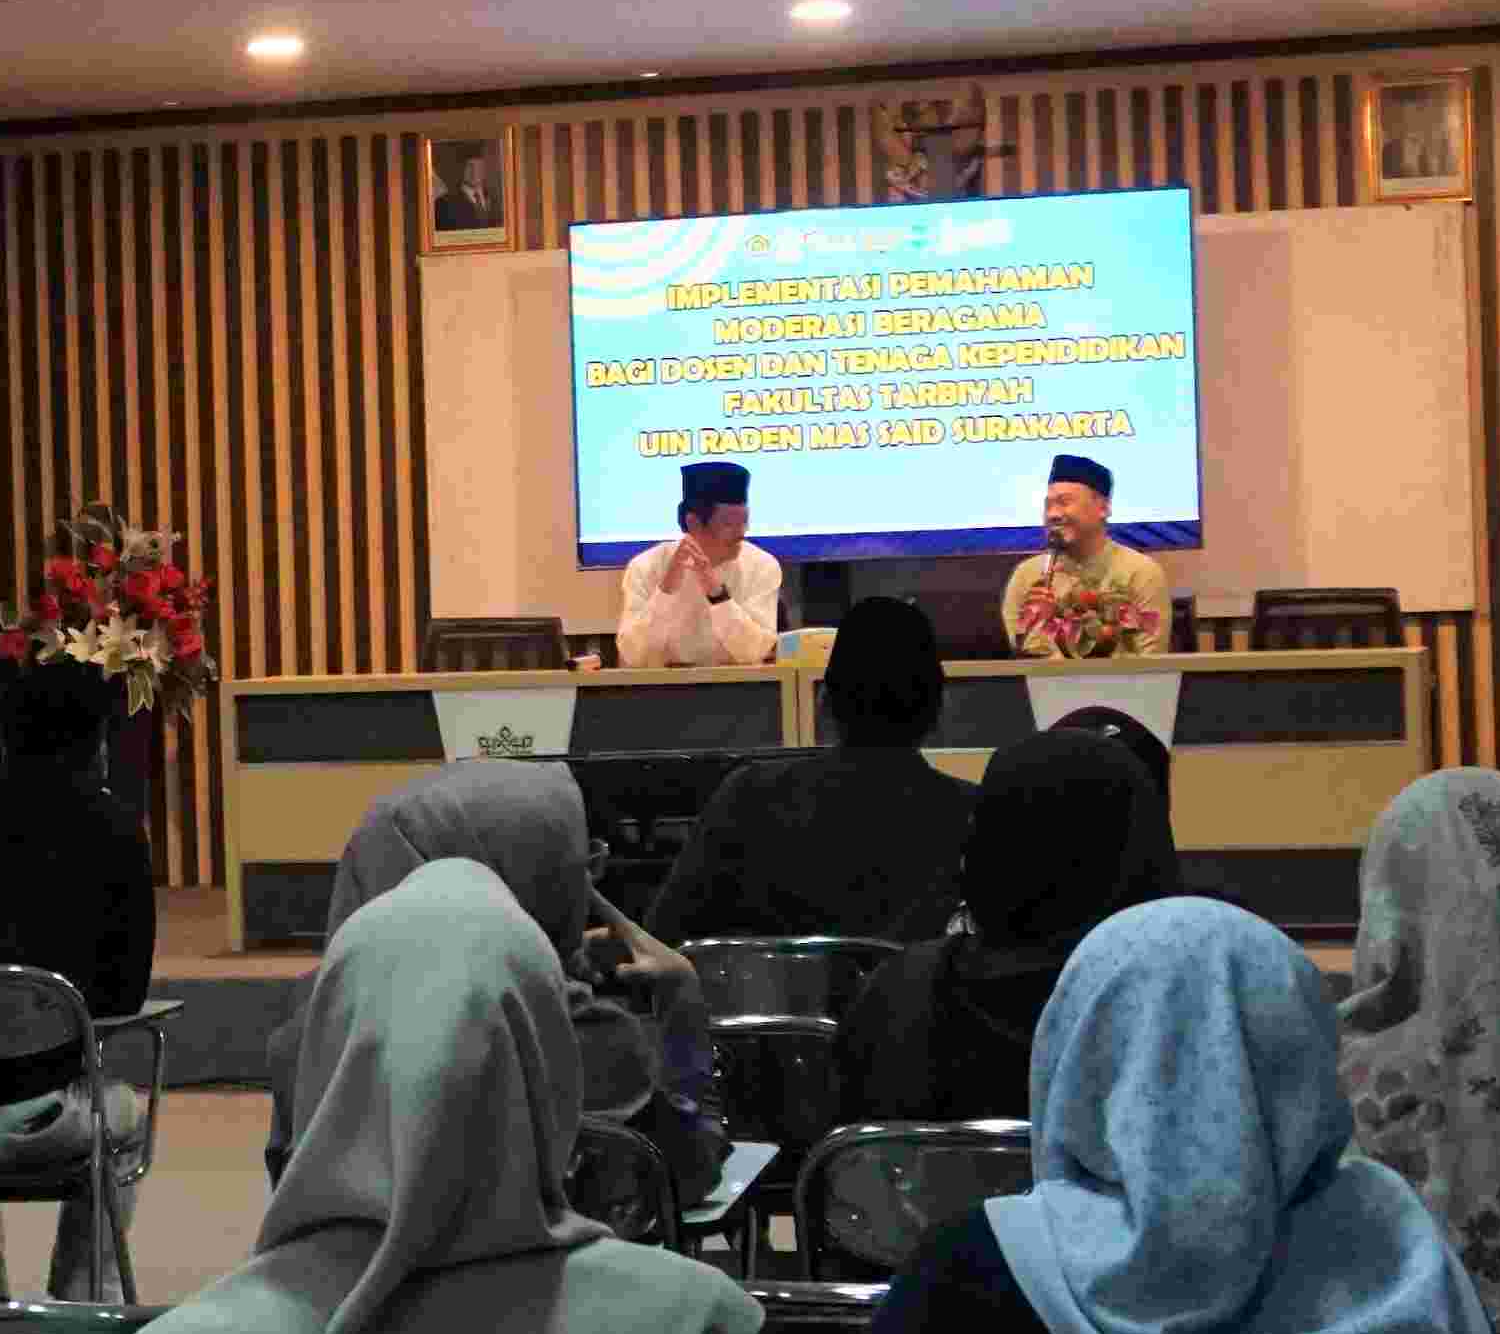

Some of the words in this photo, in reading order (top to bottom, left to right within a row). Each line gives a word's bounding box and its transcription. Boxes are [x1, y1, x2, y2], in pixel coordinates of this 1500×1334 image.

[666, 274, 881, 311] IMPLEMENTASI
[888, 263, 1095, 298] PEMAHAMAN
[713, 312, 866, 344] MODERASI
[872, 302, 1047, 336] BERAGAMA
[586, 358, 656, 387] BAGI
[660, 354, 756, 384] DOSEN
[760, 349, 826, 378] DAN
[833, 343, 953, 374] TENAGA
[958, 332, 1185, 368] KEPENDIDIKAN
[723, 385, 872, 417] FAKULTAS
[880, 377, 1034, 409] TARBIYAH
[639, 428, 693, 456] UIN
[699, 424, 803, 455] RADEN
[809, 421, 869, 451] MAS
[877, 418, 946, 447] SAID
[952, 410, 1136, 443] SURAKARTA
